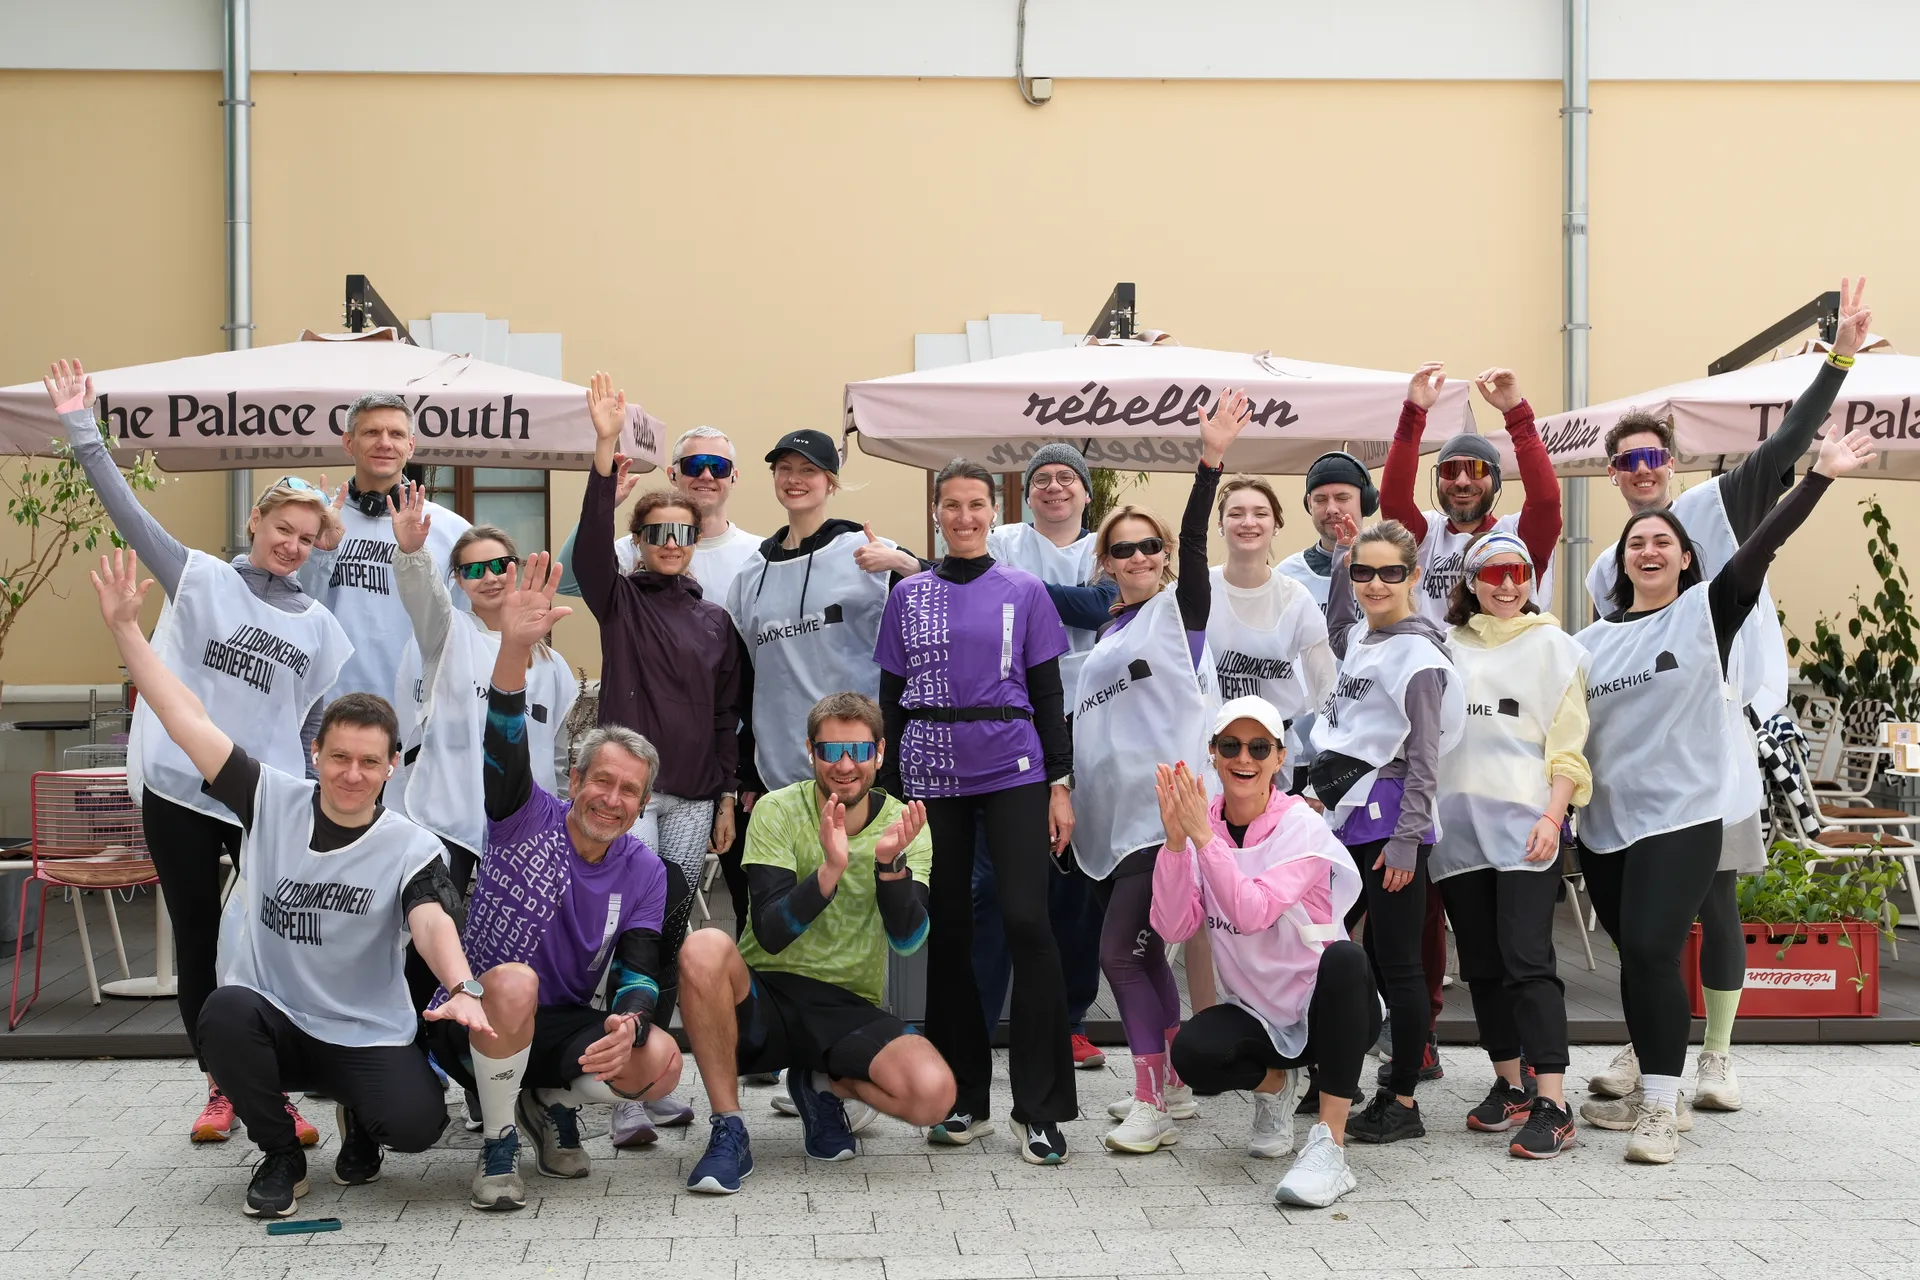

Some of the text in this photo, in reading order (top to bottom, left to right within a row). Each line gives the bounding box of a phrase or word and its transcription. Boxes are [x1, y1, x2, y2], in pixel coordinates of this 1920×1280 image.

[96, 392, 154, 439] he
[168, 391, 316, 438] Palace
[400, 394, 531, 440] Youth
[757, 619, 820, 646] ВИЖЕНИЕ
[1077, 678, 1128, 720] ИЖЕНИЕ
[1586, 669, 1652, 702] ВИЖЕНИЕ
[1747, 970, 1832, 987] rébellion
